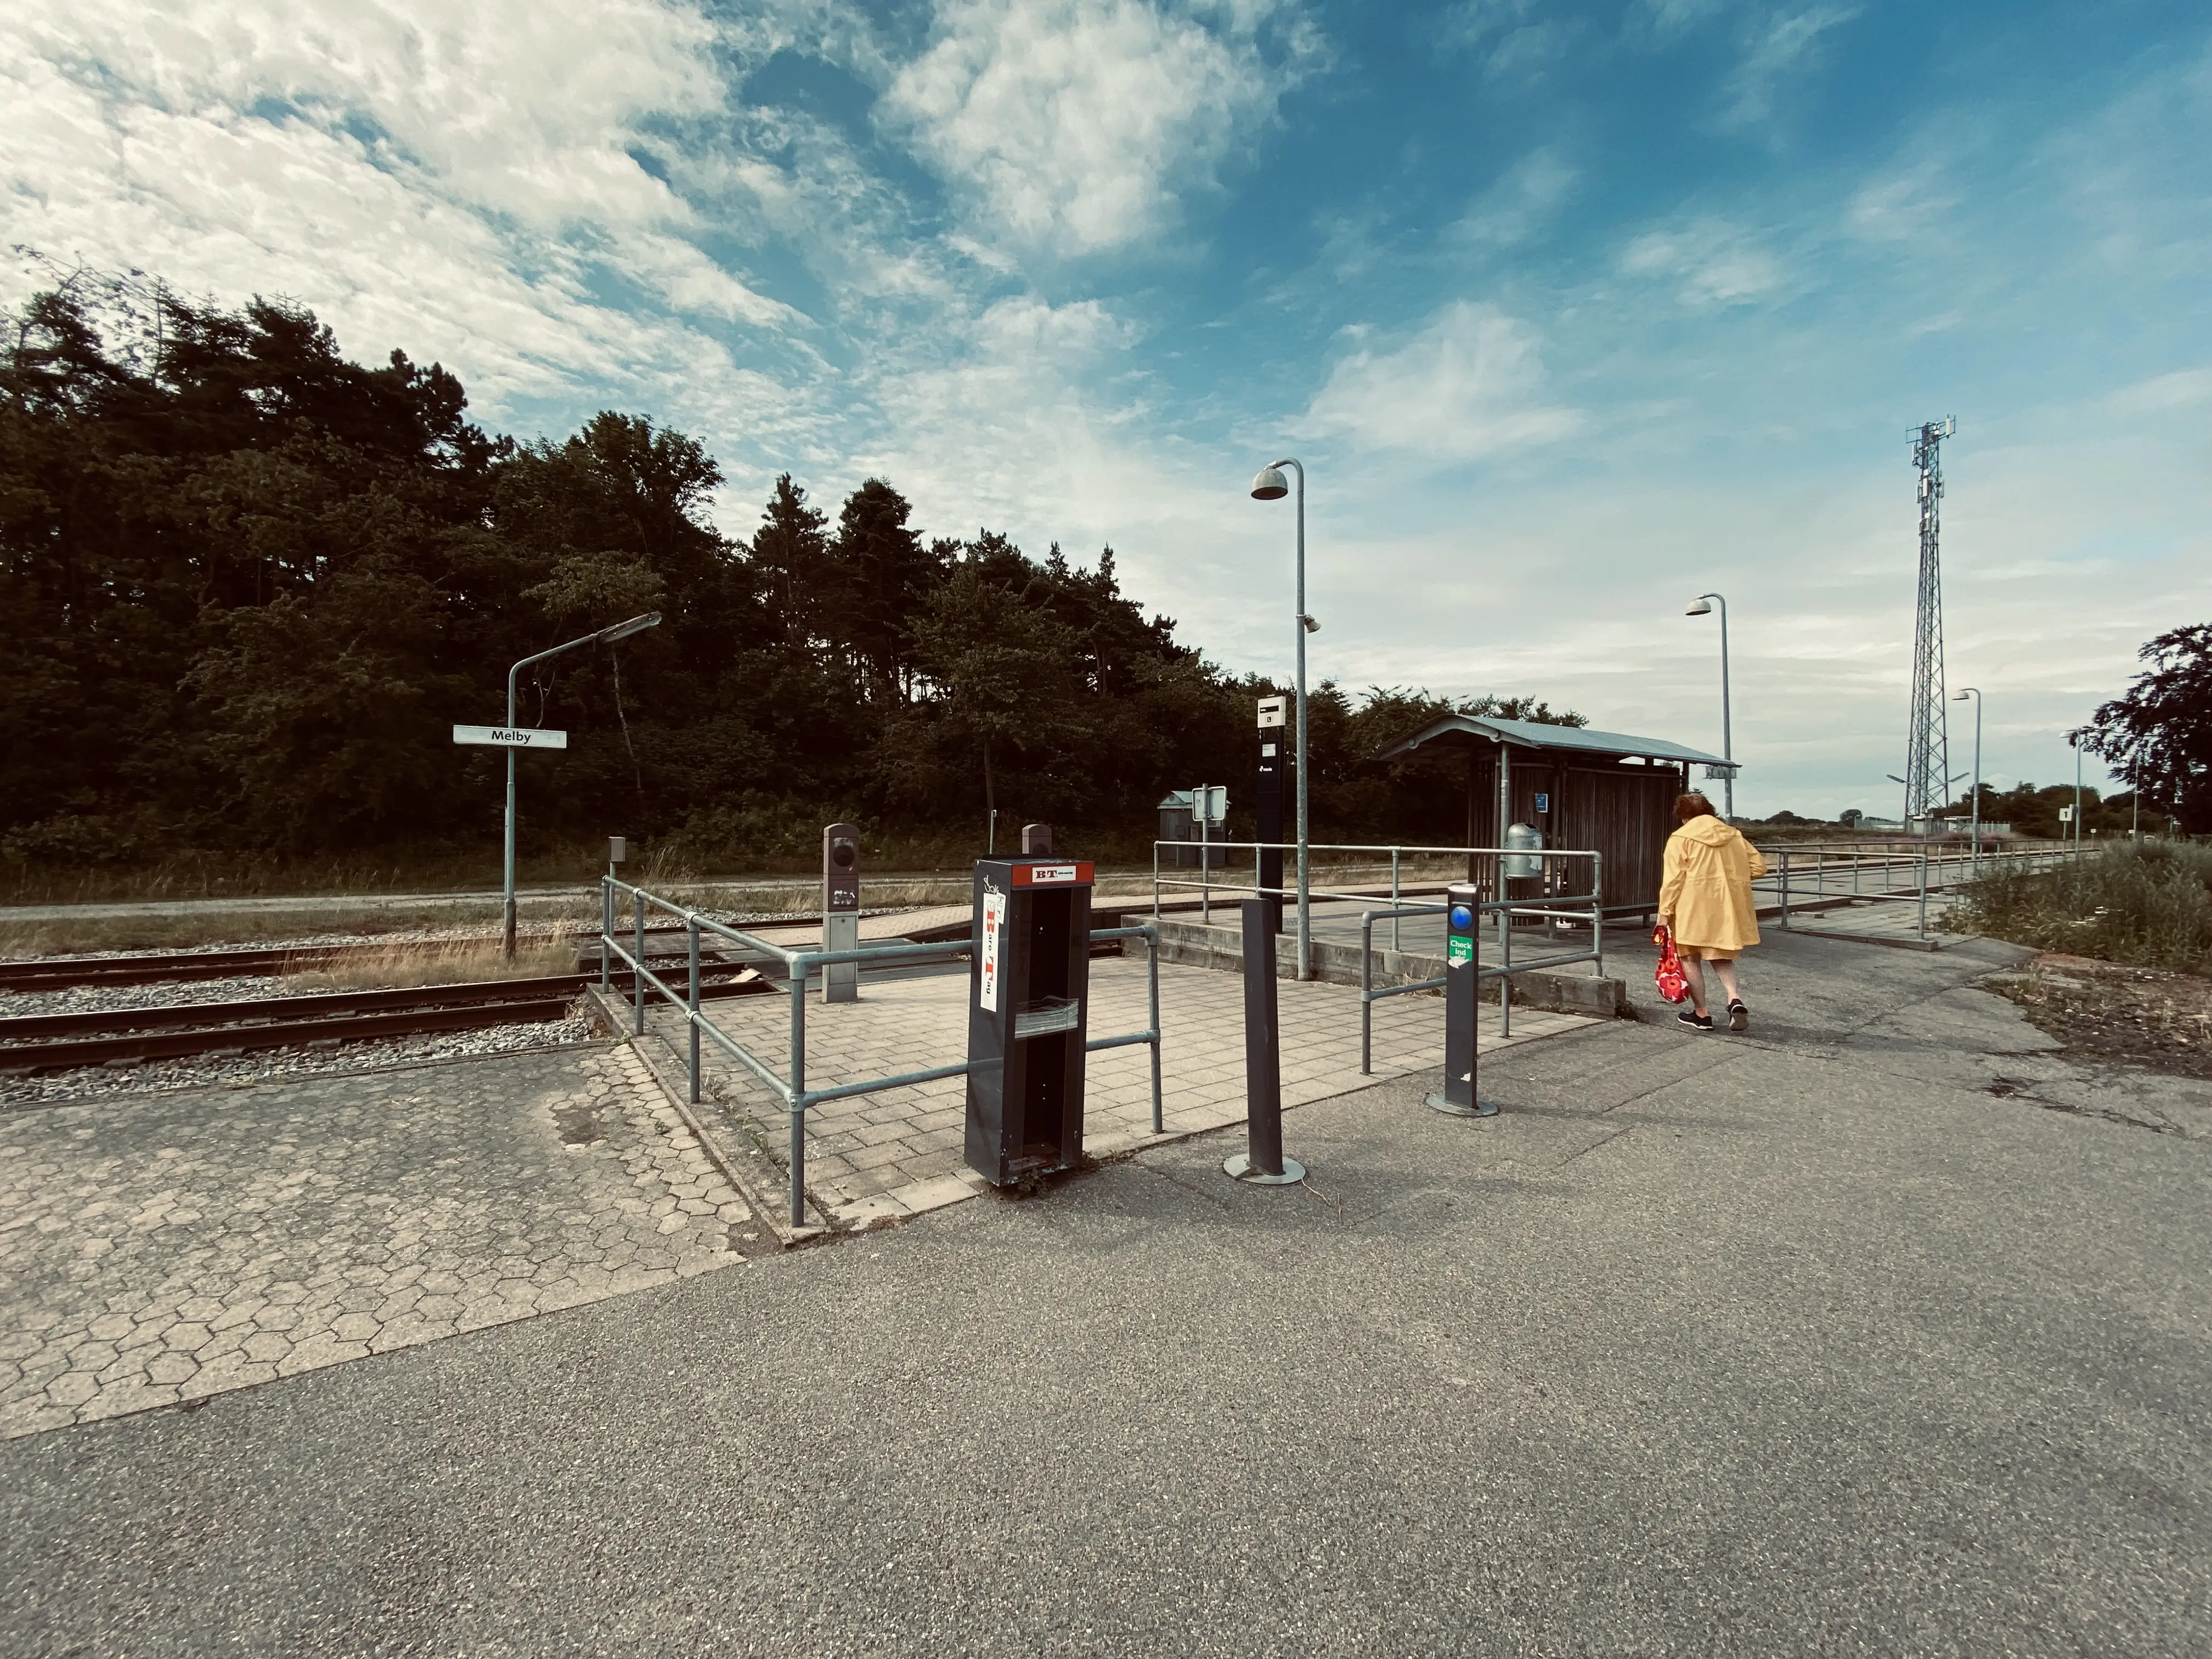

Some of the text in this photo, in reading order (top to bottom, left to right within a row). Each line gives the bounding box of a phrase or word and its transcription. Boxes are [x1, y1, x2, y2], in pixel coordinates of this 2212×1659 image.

[492, 730, 531, 744] Melby
[1451, 940, 1471, 950] Check
[985, 910, 995, 995] Bare Tag
